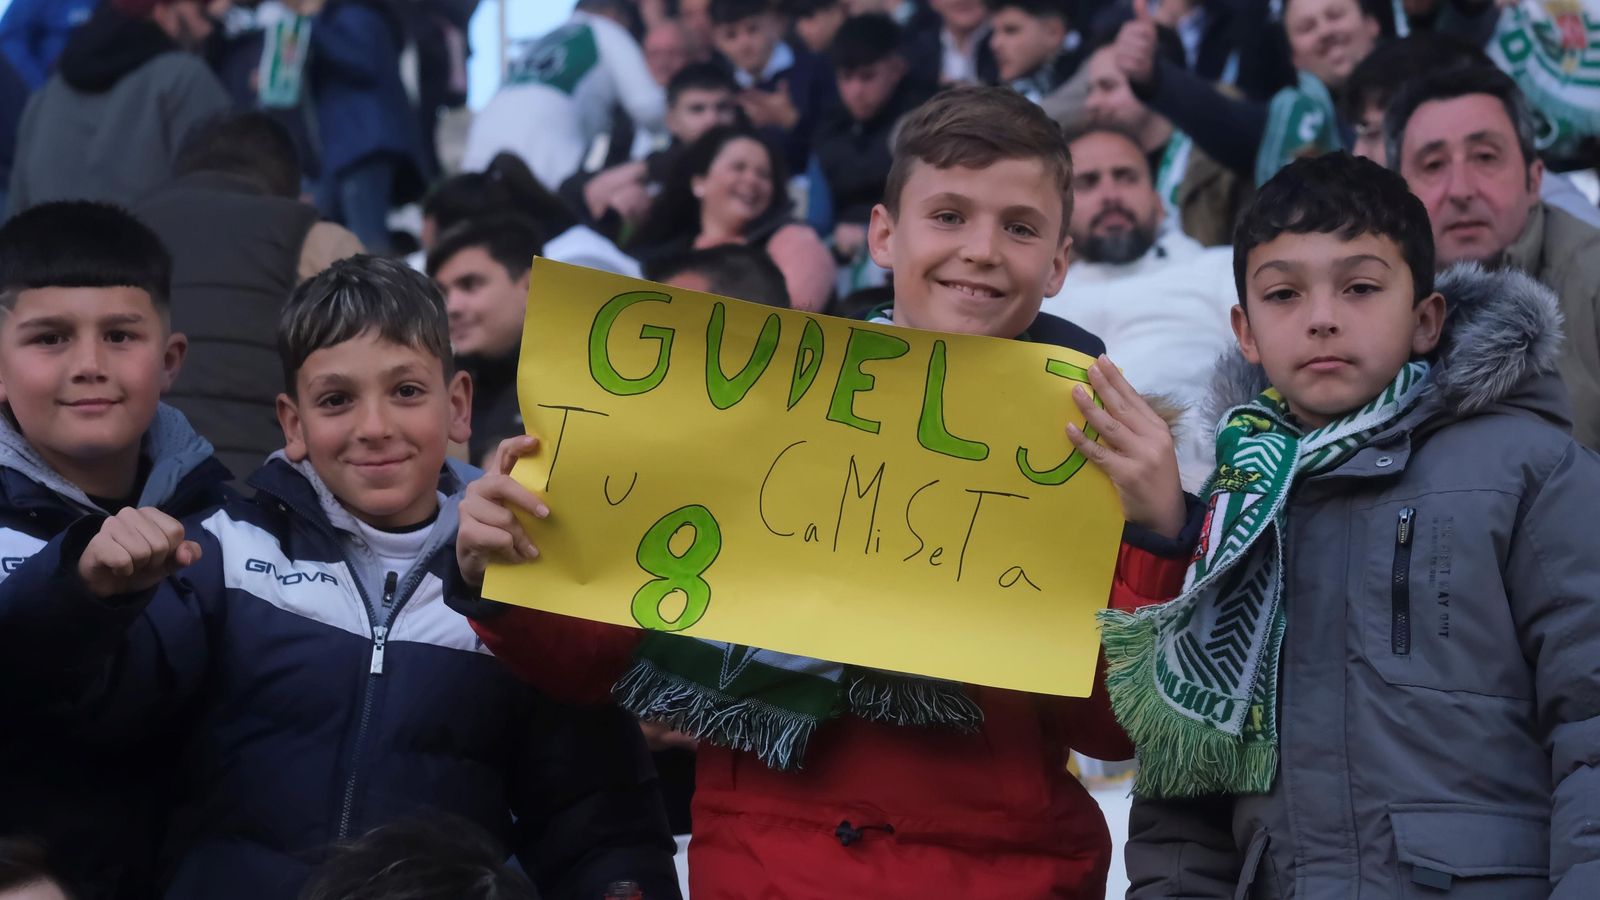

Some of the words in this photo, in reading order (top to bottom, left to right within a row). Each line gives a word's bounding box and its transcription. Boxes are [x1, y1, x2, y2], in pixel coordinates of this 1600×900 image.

[588, 290, 1104, 485] GUDELJ
[245, 558, 338, 586] GIVOVA
[630, 504, 723, 632] 8
